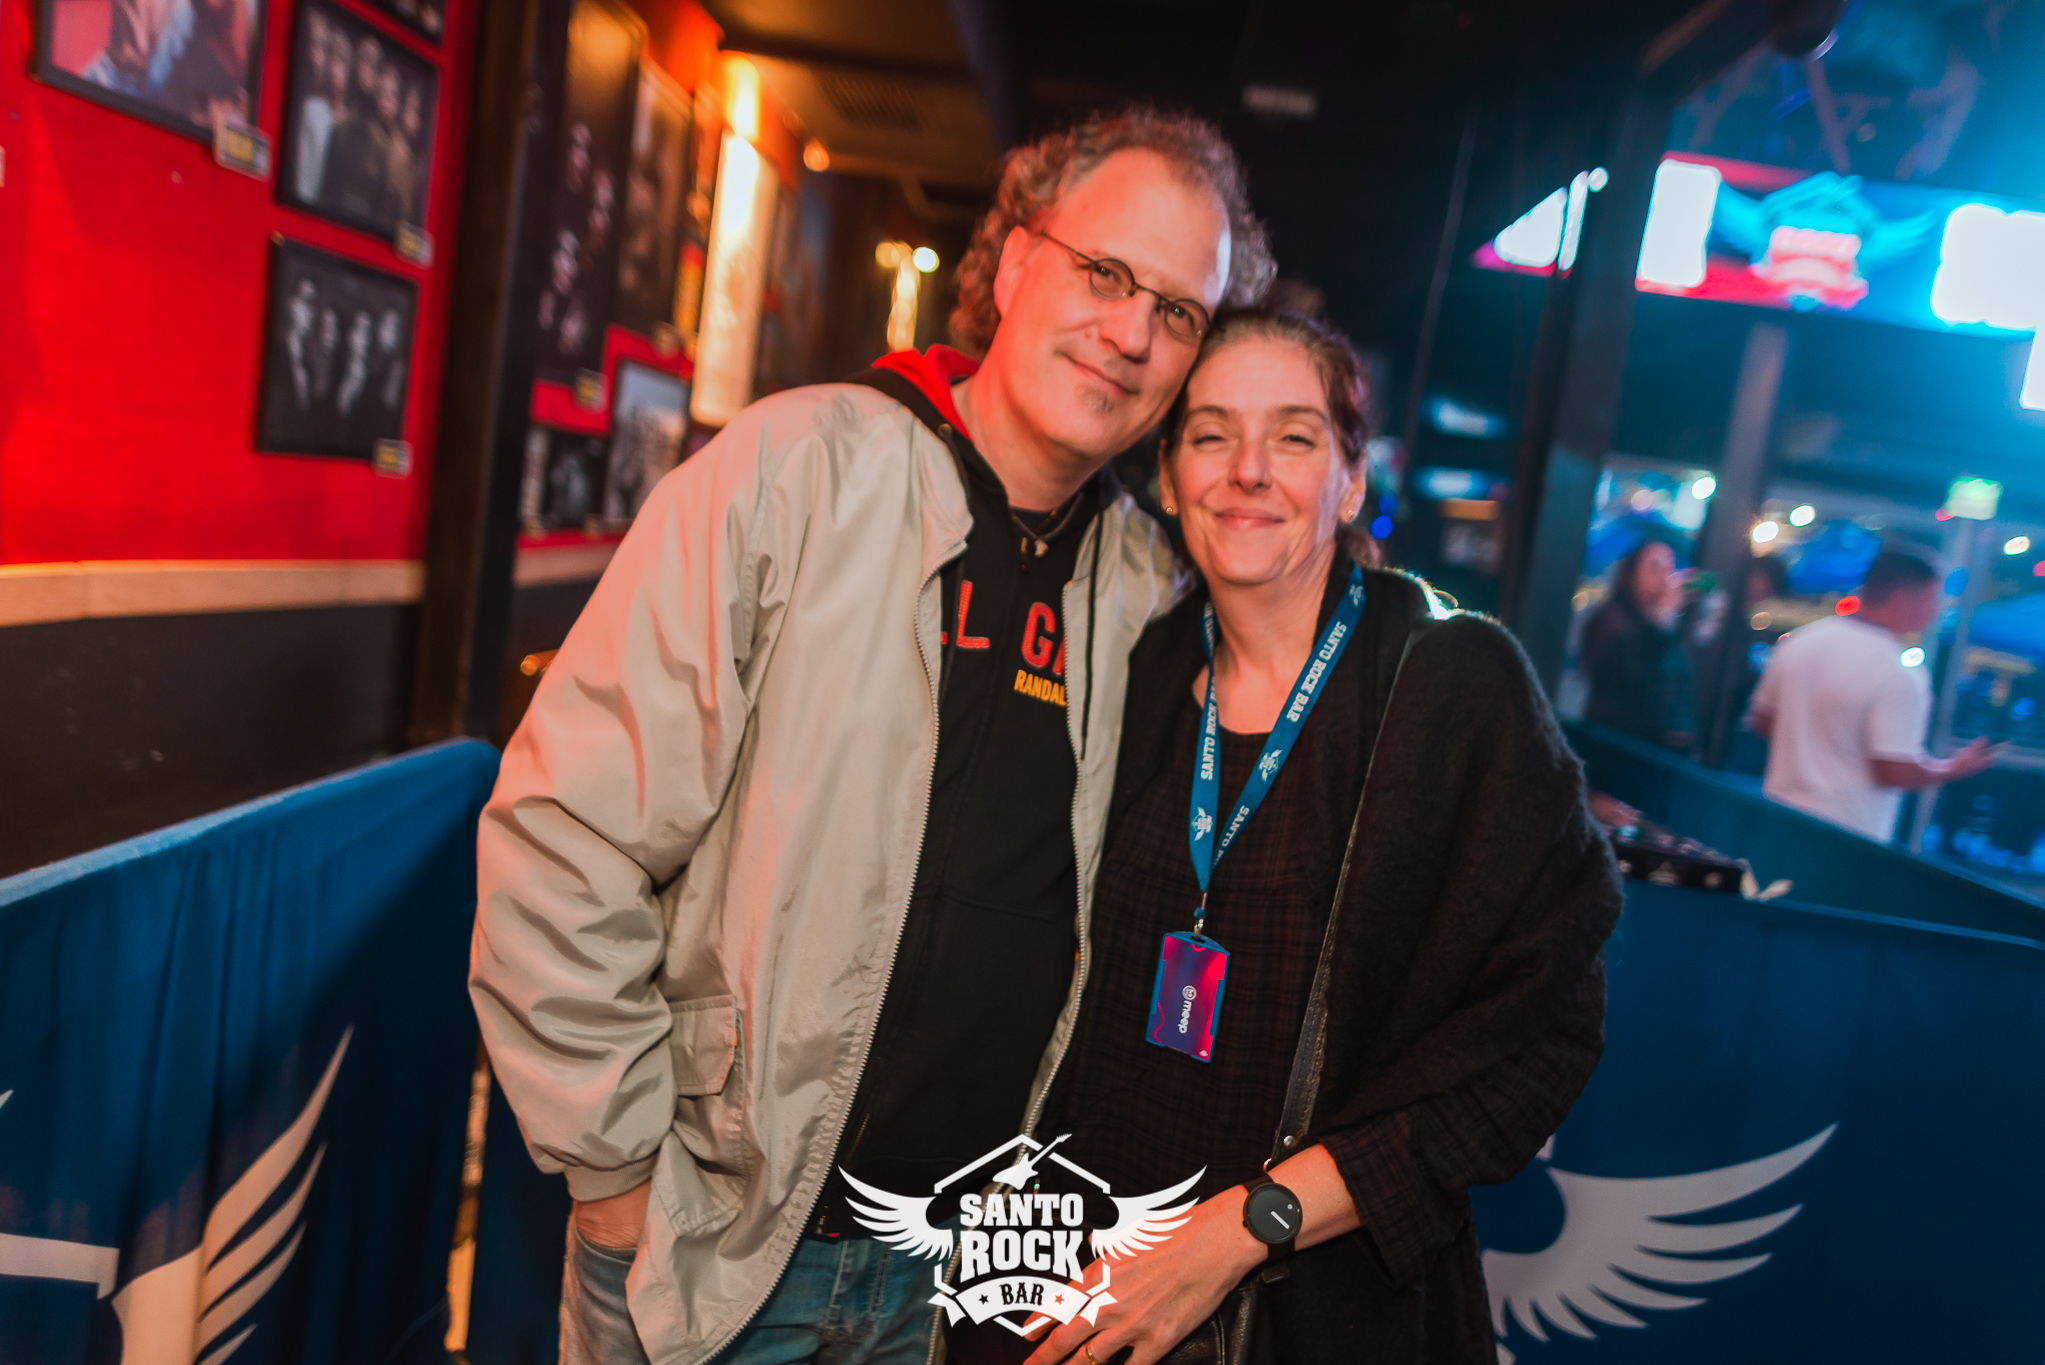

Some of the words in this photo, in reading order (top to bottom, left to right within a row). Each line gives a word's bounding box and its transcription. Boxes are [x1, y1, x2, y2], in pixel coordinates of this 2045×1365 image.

[1319, 621, 1347, 661] SANTO
[1301, 658, 1327, 694] ROCK
[1206, 701, 1217, 736] ROCK
[1286, 692, 1309, 722] BAR
[1201, 736, 1216, 780] SANTO
[1221, 805, 1250, 847] SANTO
[1178, 1000, 1192, 1034] meep
